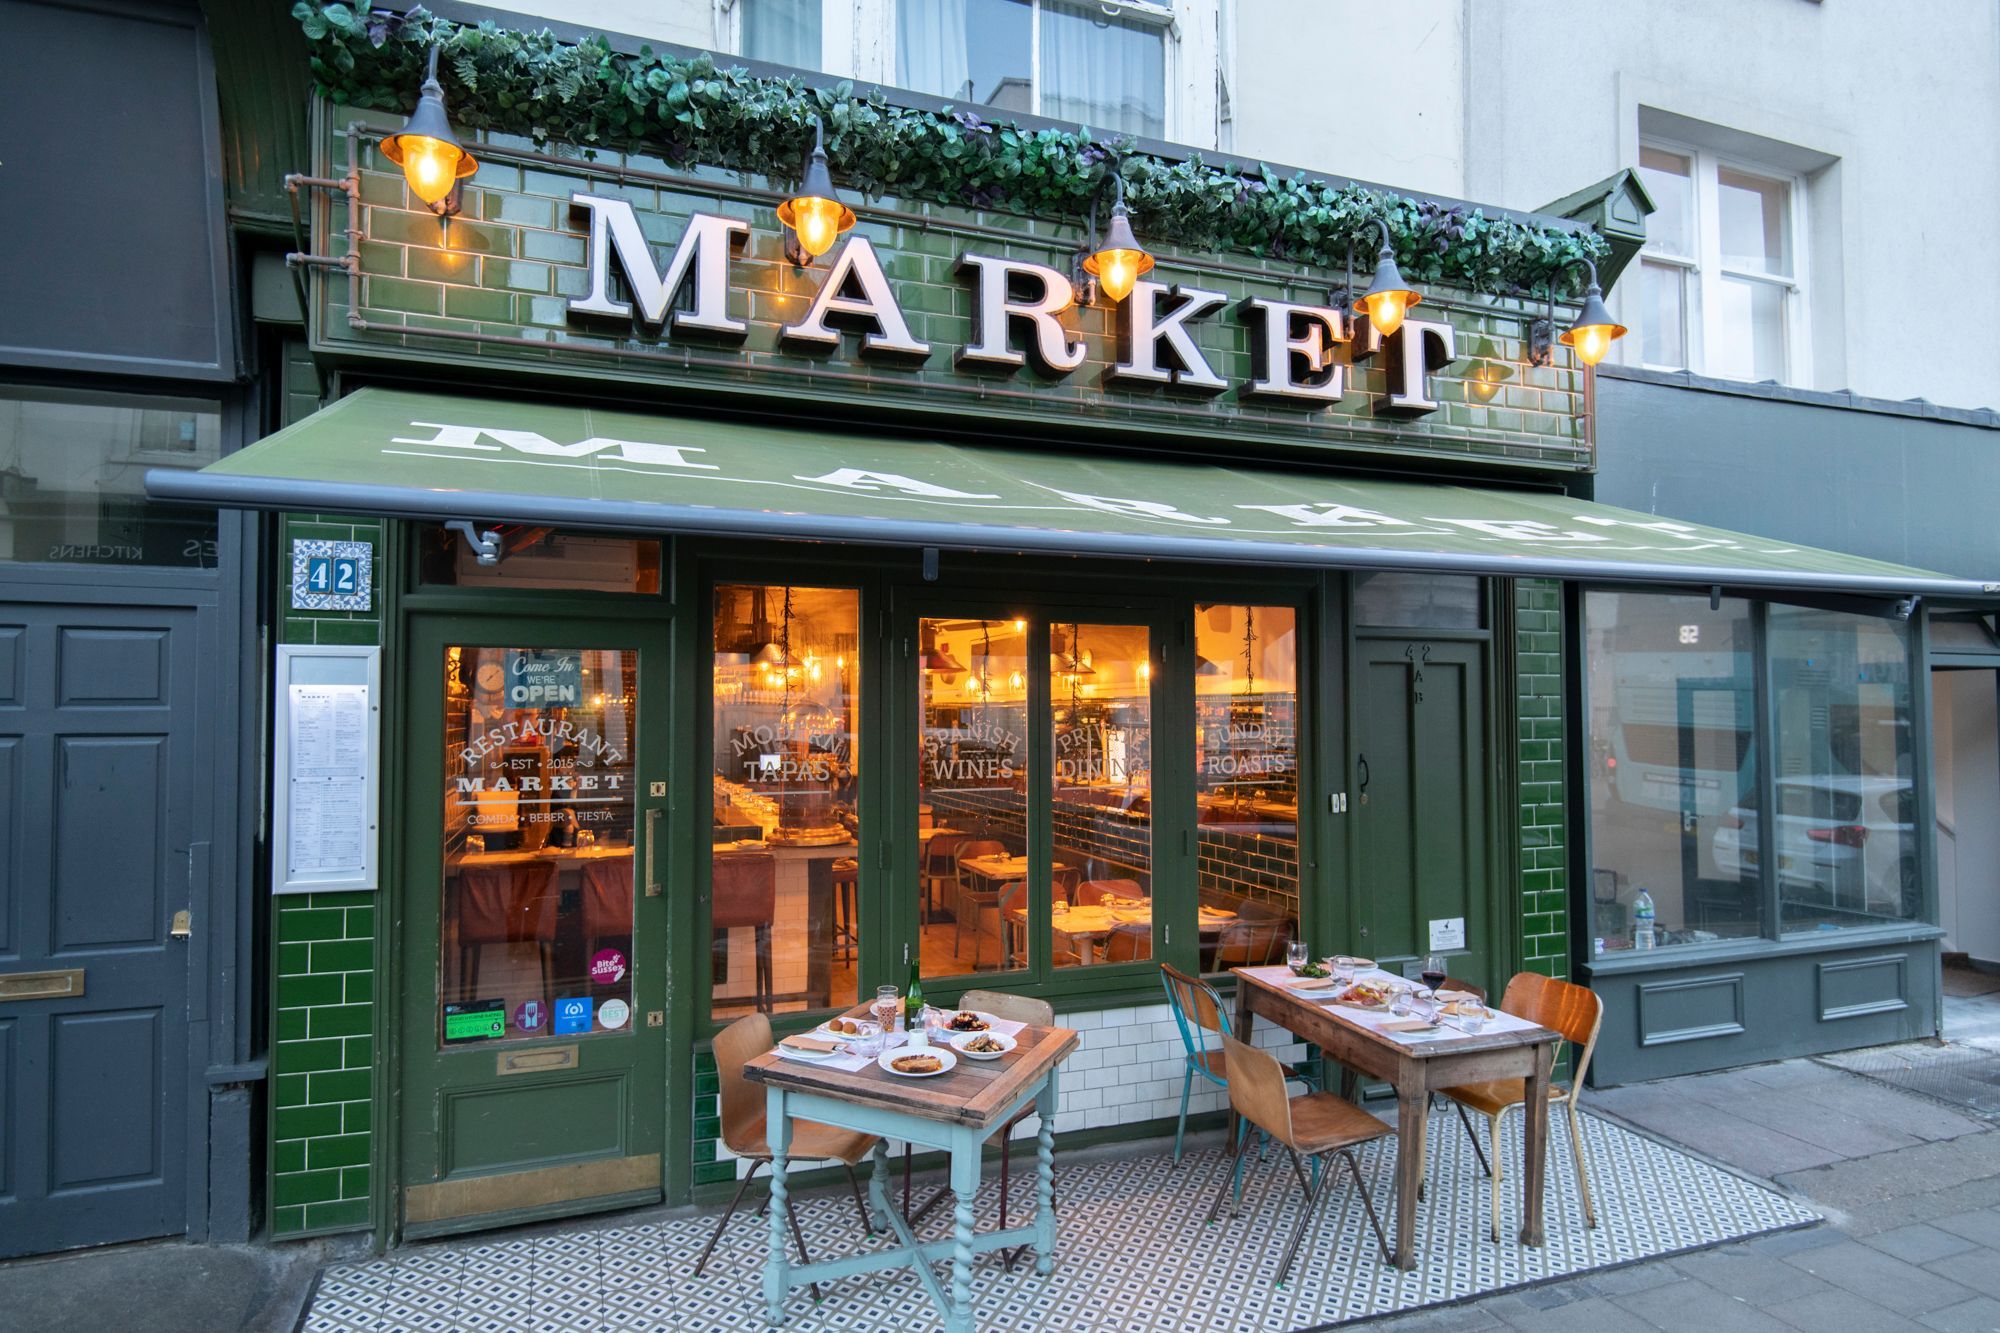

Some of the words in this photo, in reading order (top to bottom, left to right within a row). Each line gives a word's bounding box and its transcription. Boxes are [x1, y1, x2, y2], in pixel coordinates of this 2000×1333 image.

[567, 190, 1457, 412] MARKET
[391, 422, 1738, 547] MARKET
[310, 562, 354, 590] 42
[512, 656, 550, 676] Come
[553, 656, 575, 673] In
[527, 675, 556, 684] WE'RE
[511, 684, 575, 702] OPEN
[459, 718, 624, 767] RESTAURANT
[924, 722, 1022, 754] SPANISH
[1057, 724, 1144, 753] PRIVATE
[1208, 723, 1284, 749] SUNDAY
[511, 759, 534, 770] EST
[546, 758, 574, 769] 2015
[743, 760, 830, 782] TAPAS
[931, 758, 1013, 780] WINES
[1060, 758, 1144, 778] DINING
[1208, 755, 1286, 775] ROASTS
[455, 775, 624, 793] MARKET
[467, 814, 516, 825] COMIDA
[529, 813, 565, 823] BEBER
[577, 811, 614, 821] FIESTA
[591, 965, 624, 975] Sussex
[597, 960, 615, 968] Bite
[602, 1008, 625, 1019] BEST
